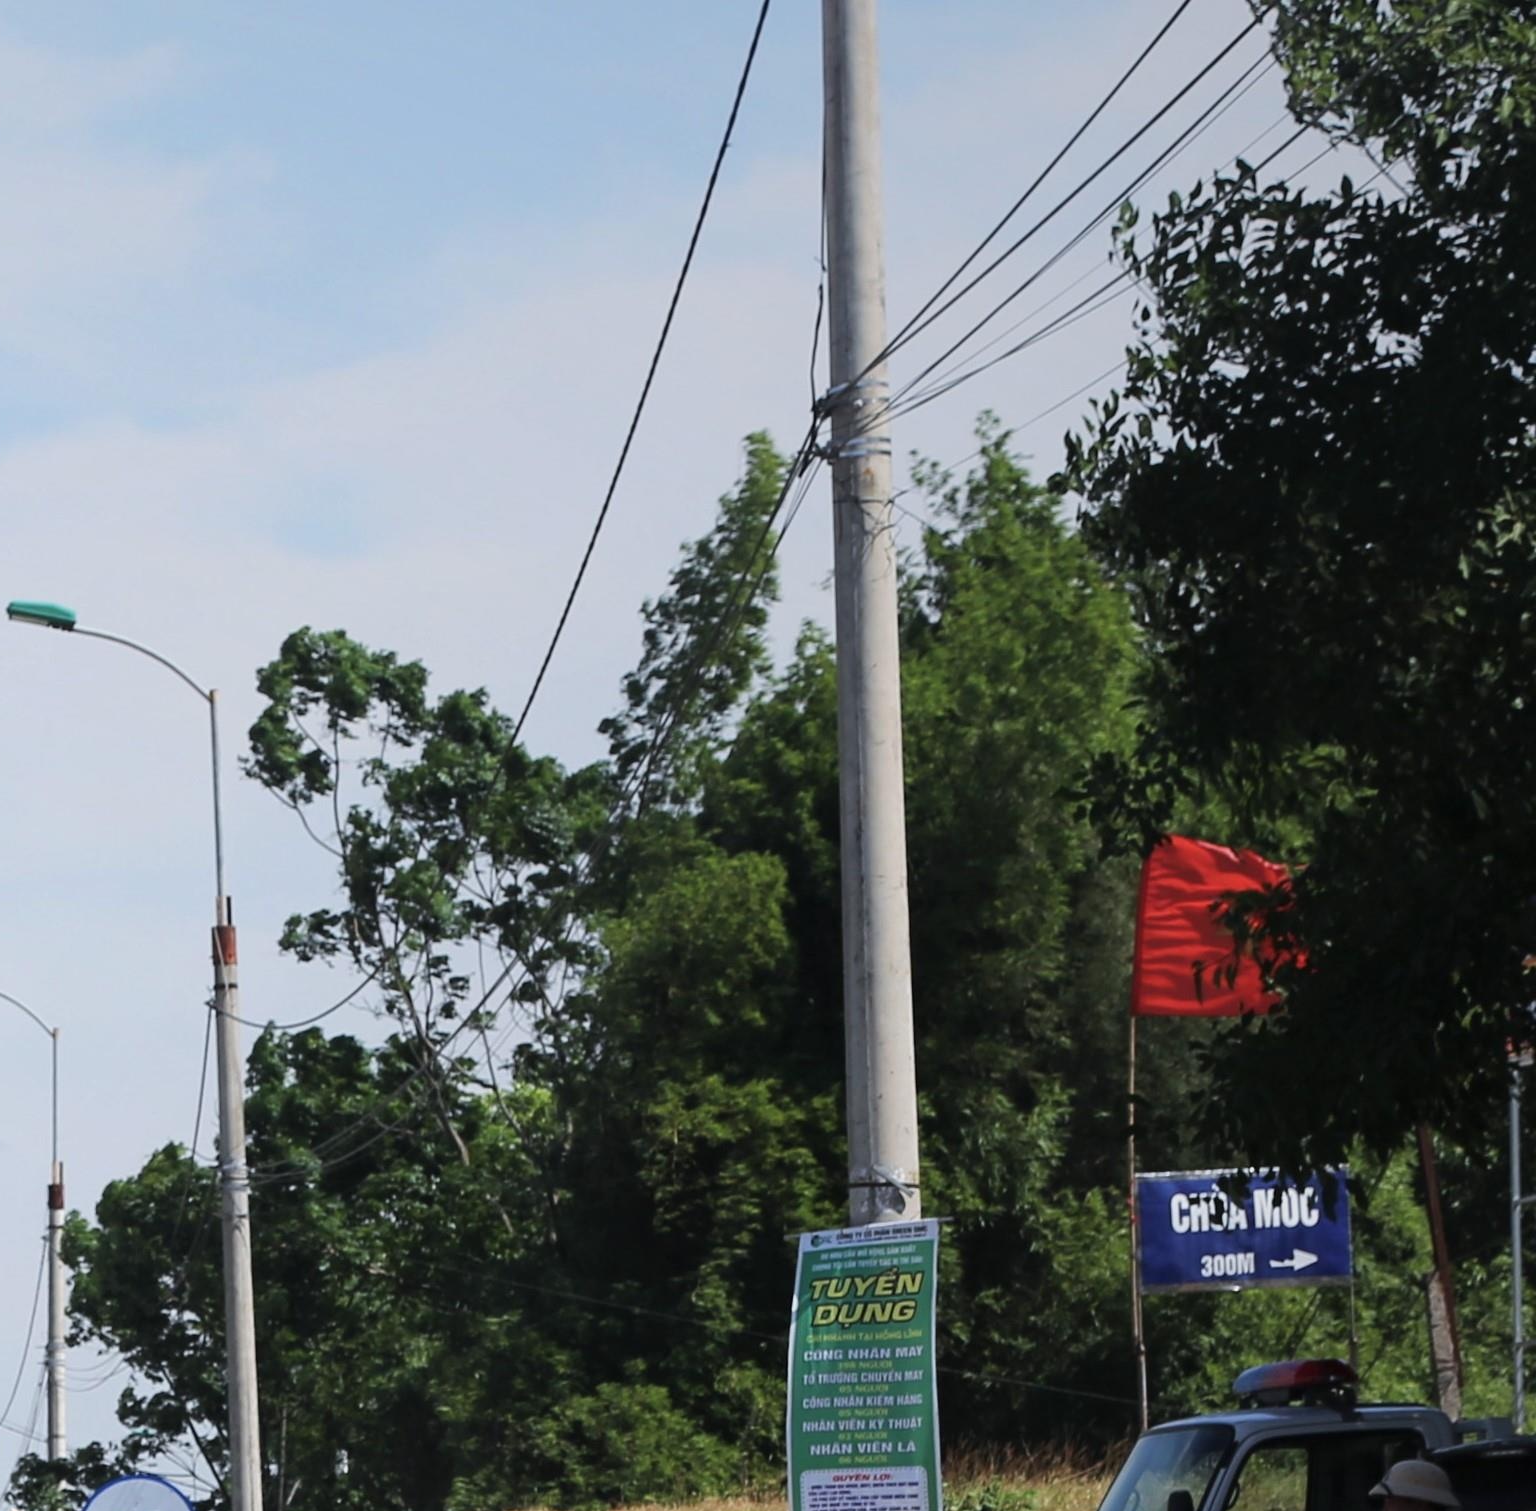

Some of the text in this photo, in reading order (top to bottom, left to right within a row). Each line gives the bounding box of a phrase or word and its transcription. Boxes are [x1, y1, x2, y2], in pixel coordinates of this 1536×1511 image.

[1201, 1253, 1254, 1277] 300M
[813, 1299, 917, 1328] DỤNG
[896, 1346, 923, 1357] MAY
